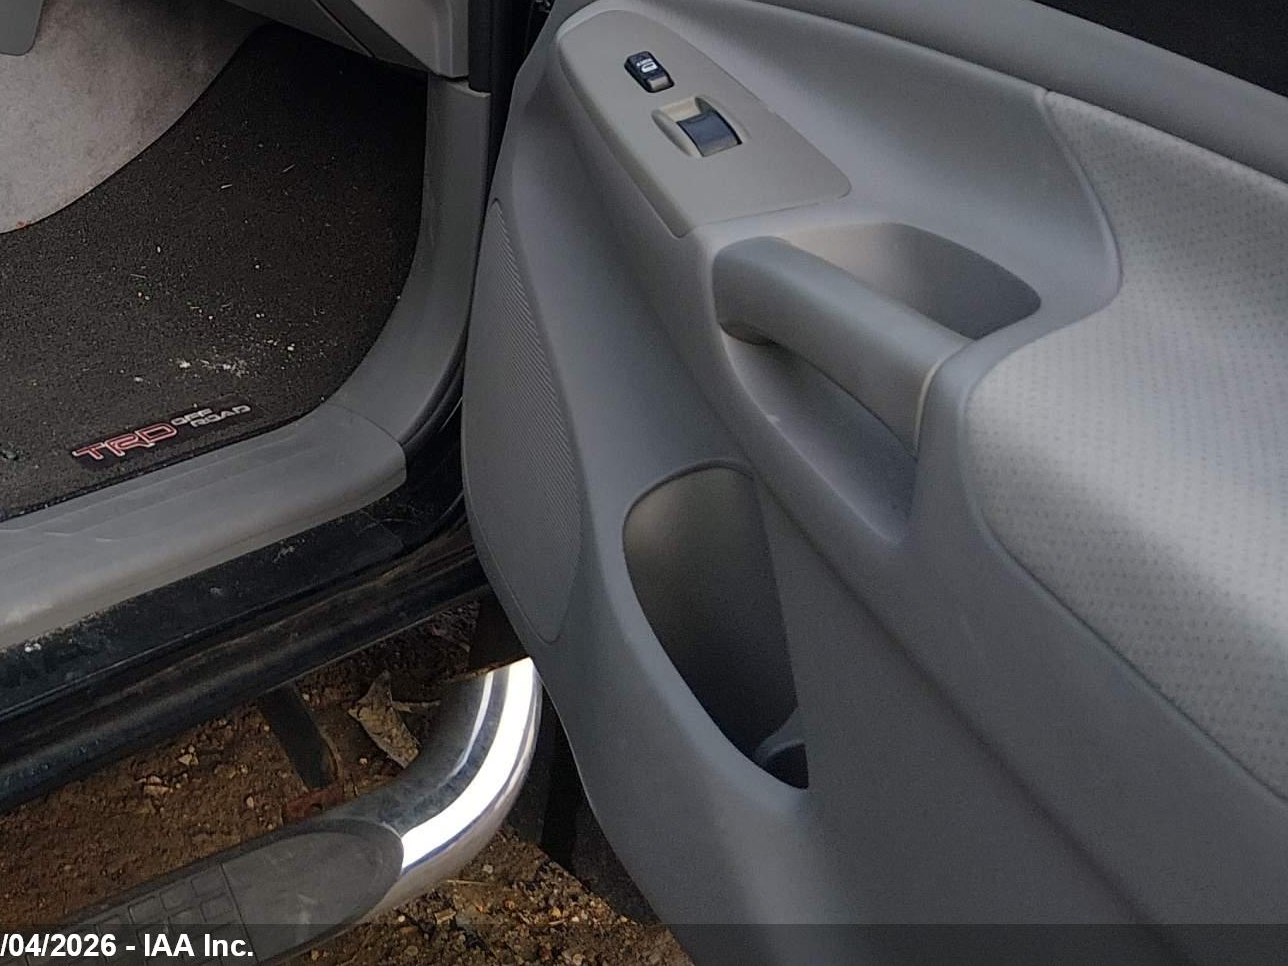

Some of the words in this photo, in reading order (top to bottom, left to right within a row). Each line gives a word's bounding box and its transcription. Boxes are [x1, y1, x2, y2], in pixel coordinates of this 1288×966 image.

[171, 408, 213, 426] OFF
[190, 405, 252, 428] ROAD
[72, 422, 178, 460] TRD
